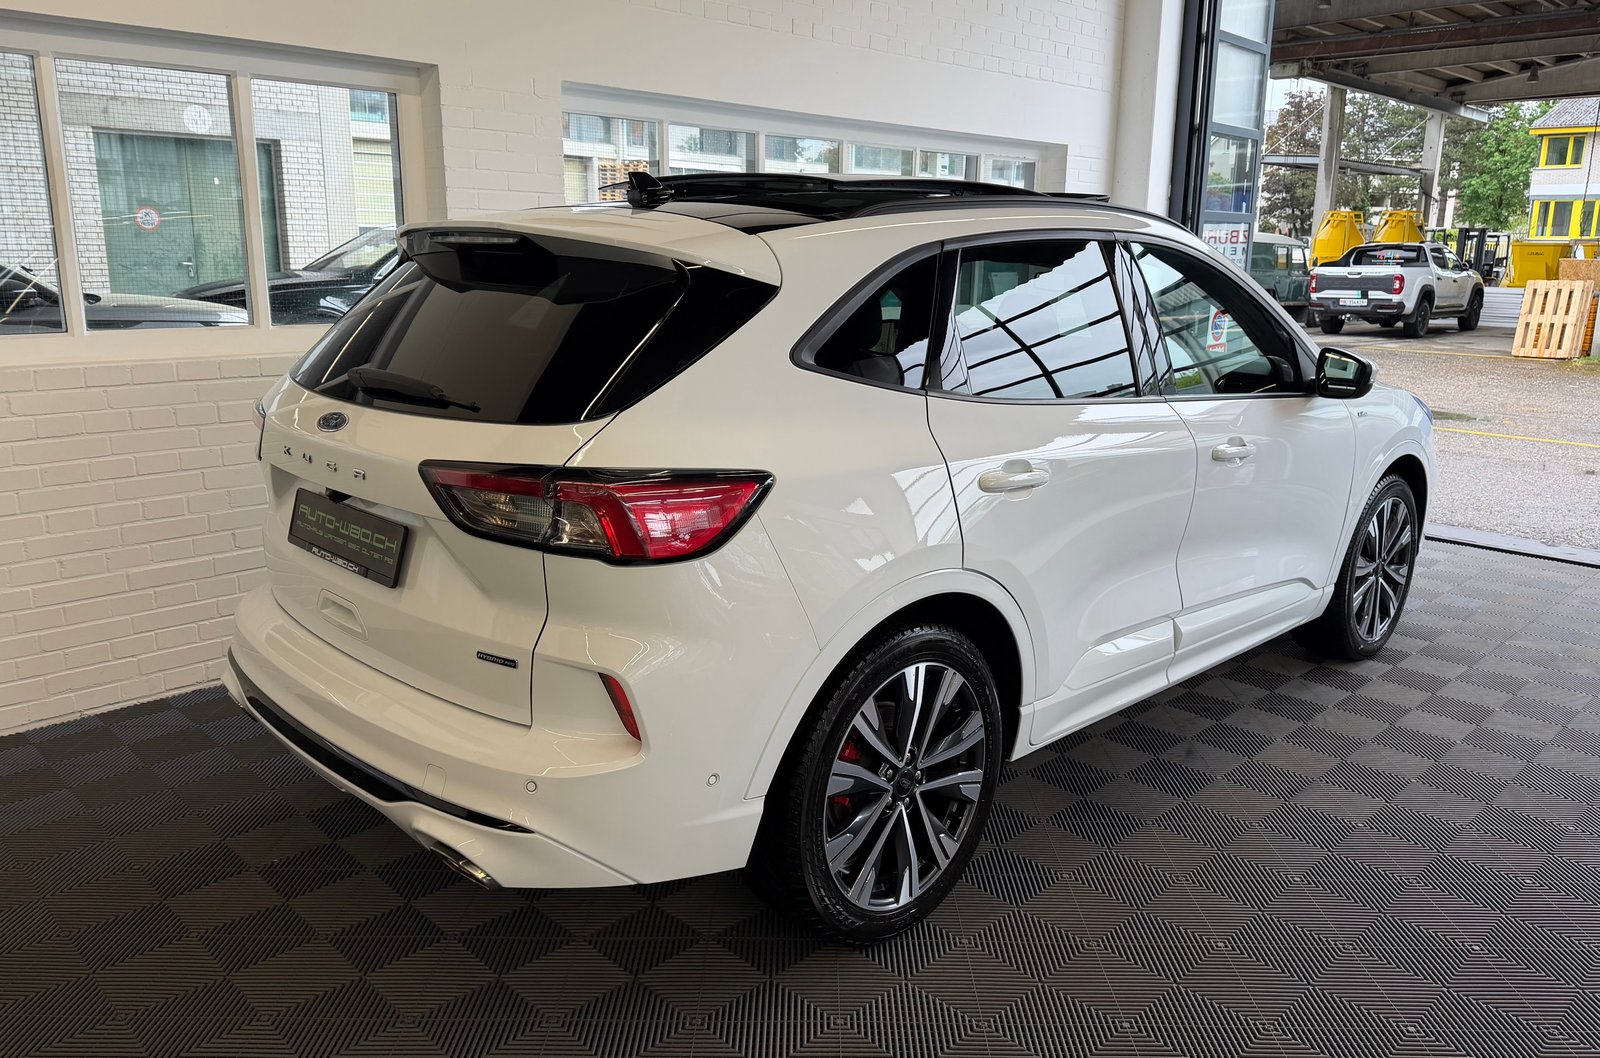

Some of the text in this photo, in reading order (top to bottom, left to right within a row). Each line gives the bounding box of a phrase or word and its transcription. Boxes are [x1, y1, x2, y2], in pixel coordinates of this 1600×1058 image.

[284, 445, 366, 480] KUGA
[298, 504, 397, 553] AUTO-WBO.CH
[477, 653, 504, 664] HYBRID
